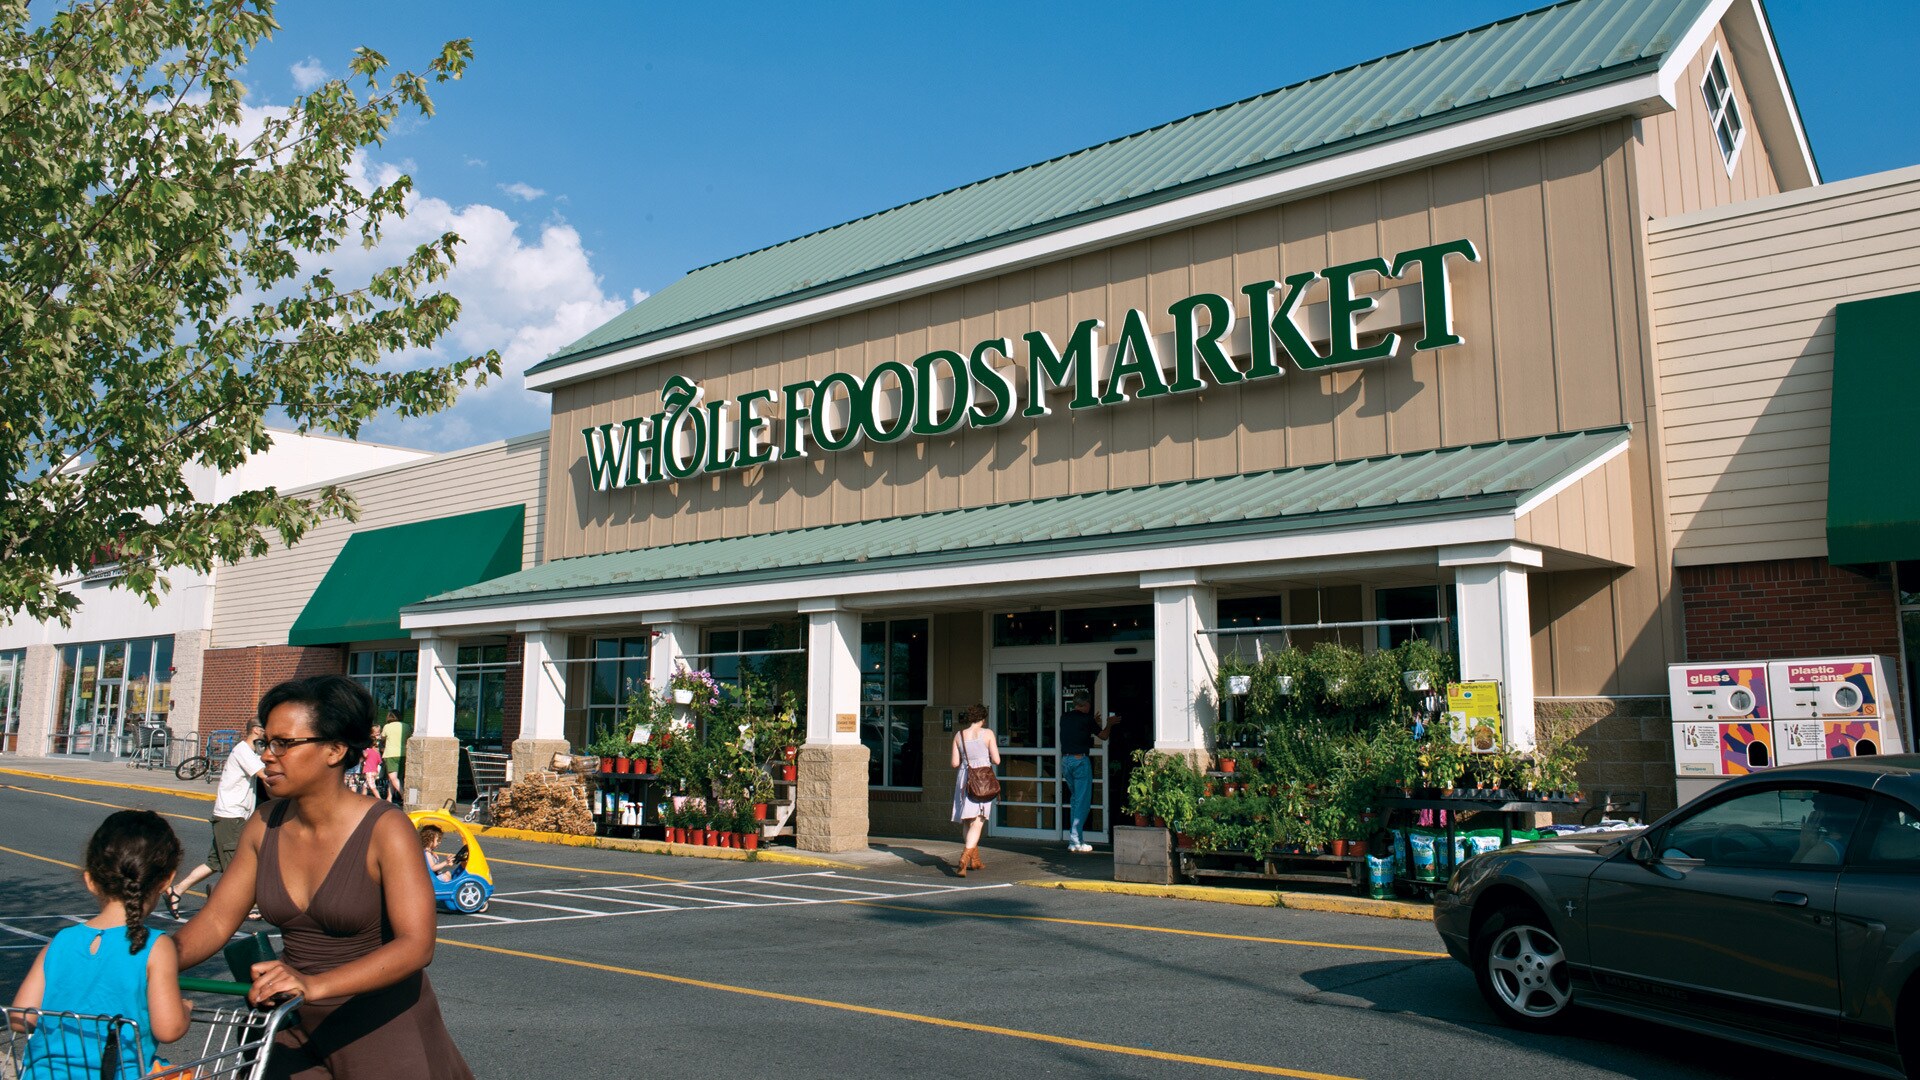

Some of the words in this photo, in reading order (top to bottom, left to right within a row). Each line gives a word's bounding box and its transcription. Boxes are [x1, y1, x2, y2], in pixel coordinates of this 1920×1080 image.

[580, 375, 778, 492] WHOLE
[782, 337, 1017, 460] FOODS
[1022, 238, 1481, 419] MARKET
[1791, 665, 1834, 676] plastic
[1690, 673, 1731, 685] glass
[1810, 674, 1846, 683] cans
[1605, 976, 1688, 999] MUSTANG
